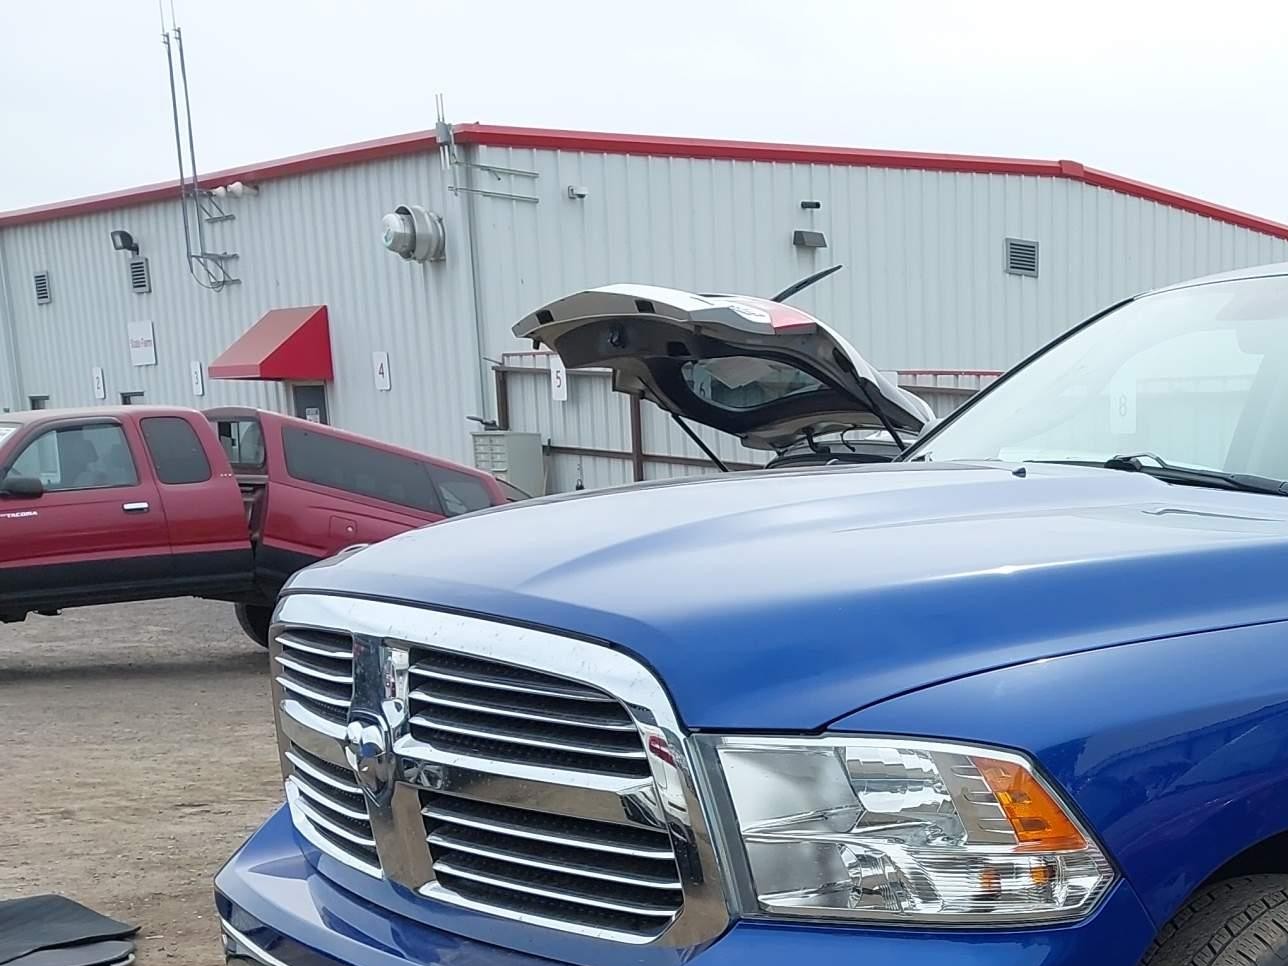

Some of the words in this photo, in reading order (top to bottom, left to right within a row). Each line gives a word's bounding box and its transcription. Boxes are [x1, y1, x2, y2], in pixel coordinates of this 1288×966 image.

[194, 371, 199, 385] 3
[378, 362, 385, 379] 4
[95, 376, 101, 390] 2
[555, 370, 562, 388] 5
[1119, 394, 1128, 417] 8
[7, 511, 38, 519] TACOMA
